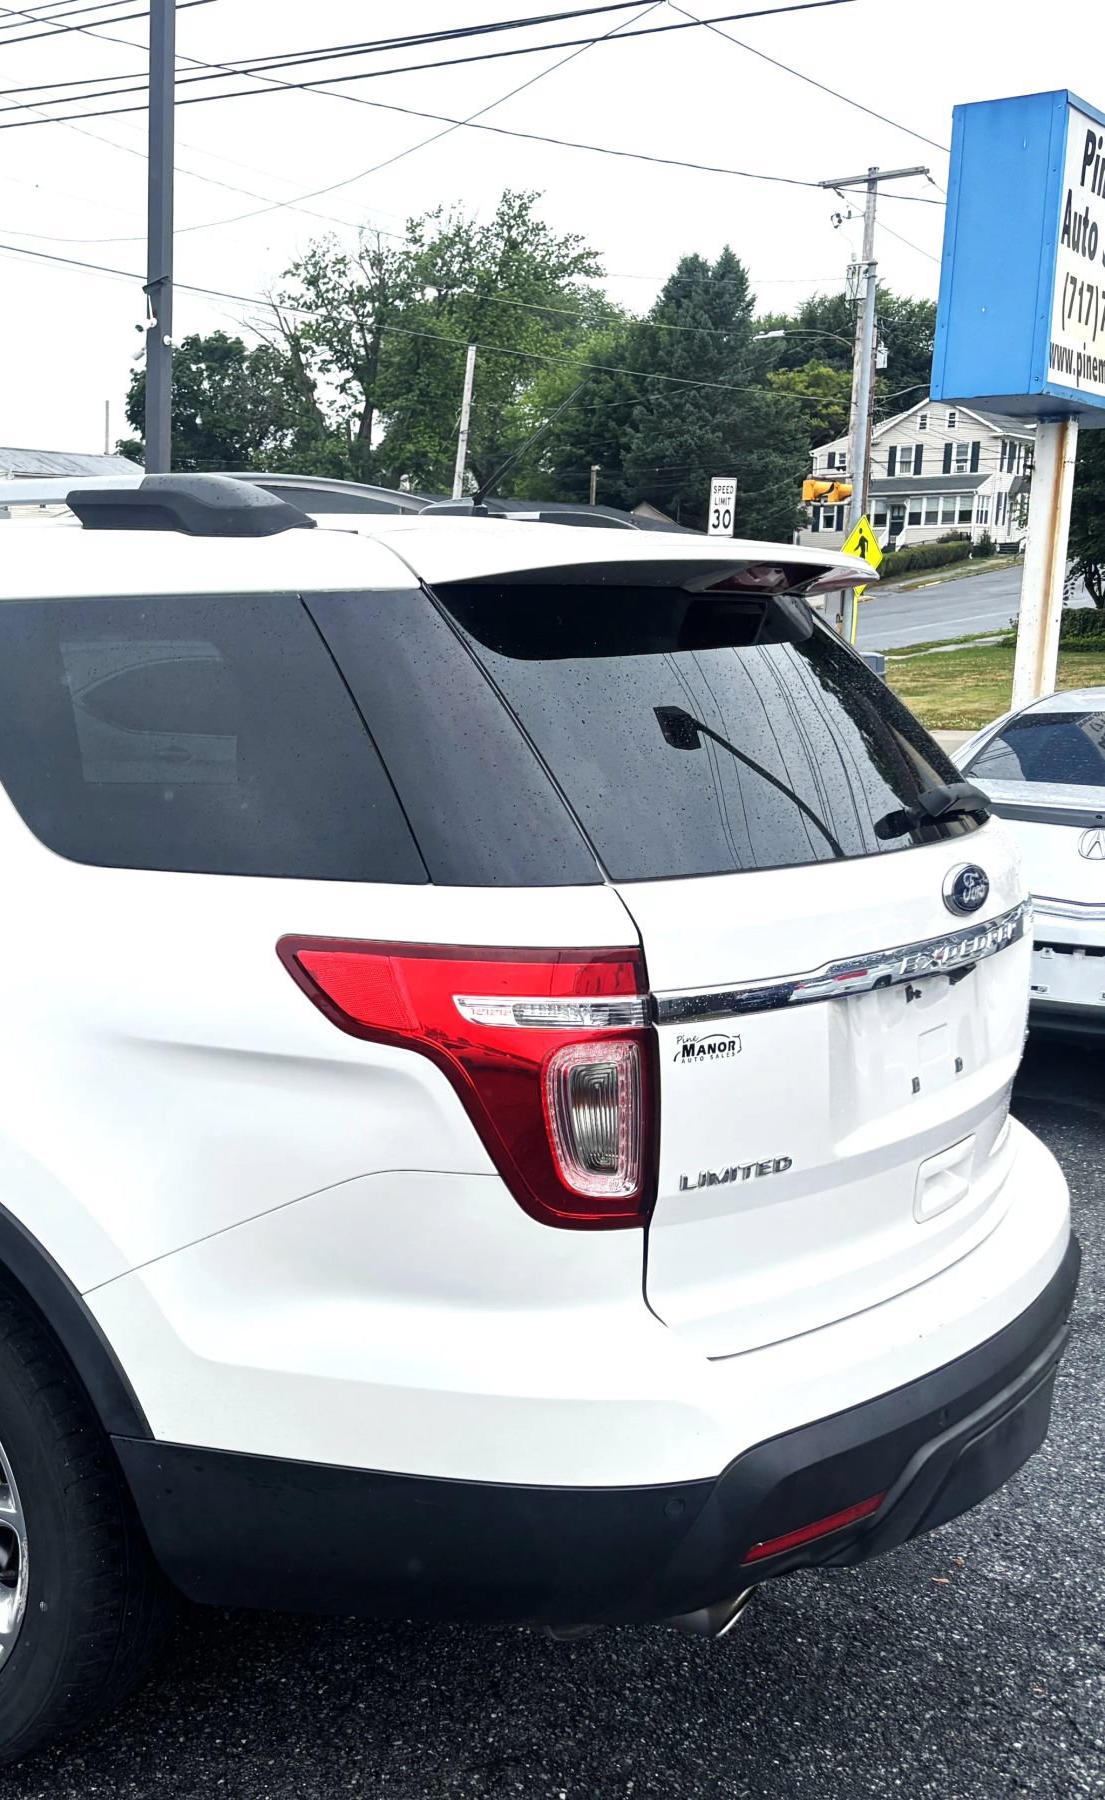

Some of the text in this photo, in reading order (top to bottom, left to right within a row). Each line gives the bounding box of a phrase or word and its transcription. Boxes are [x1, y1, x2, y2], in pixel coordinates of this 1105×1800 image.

[1060, 188, 1099, 261] Auto
[1061, 271, 1099, 342] (717)
[713, 485, 735, 495] SPEED
[714, 497, 732, 506] LIMIT
[712, 508, 732, 529] 30
[676, 1034, 700, 1046] Pine
[681, 1040, 736, 1058] MANOR
[681, 1051, 736, 1065] AUTO SALES
[679, 1156, 793, 1192] LIMITED
